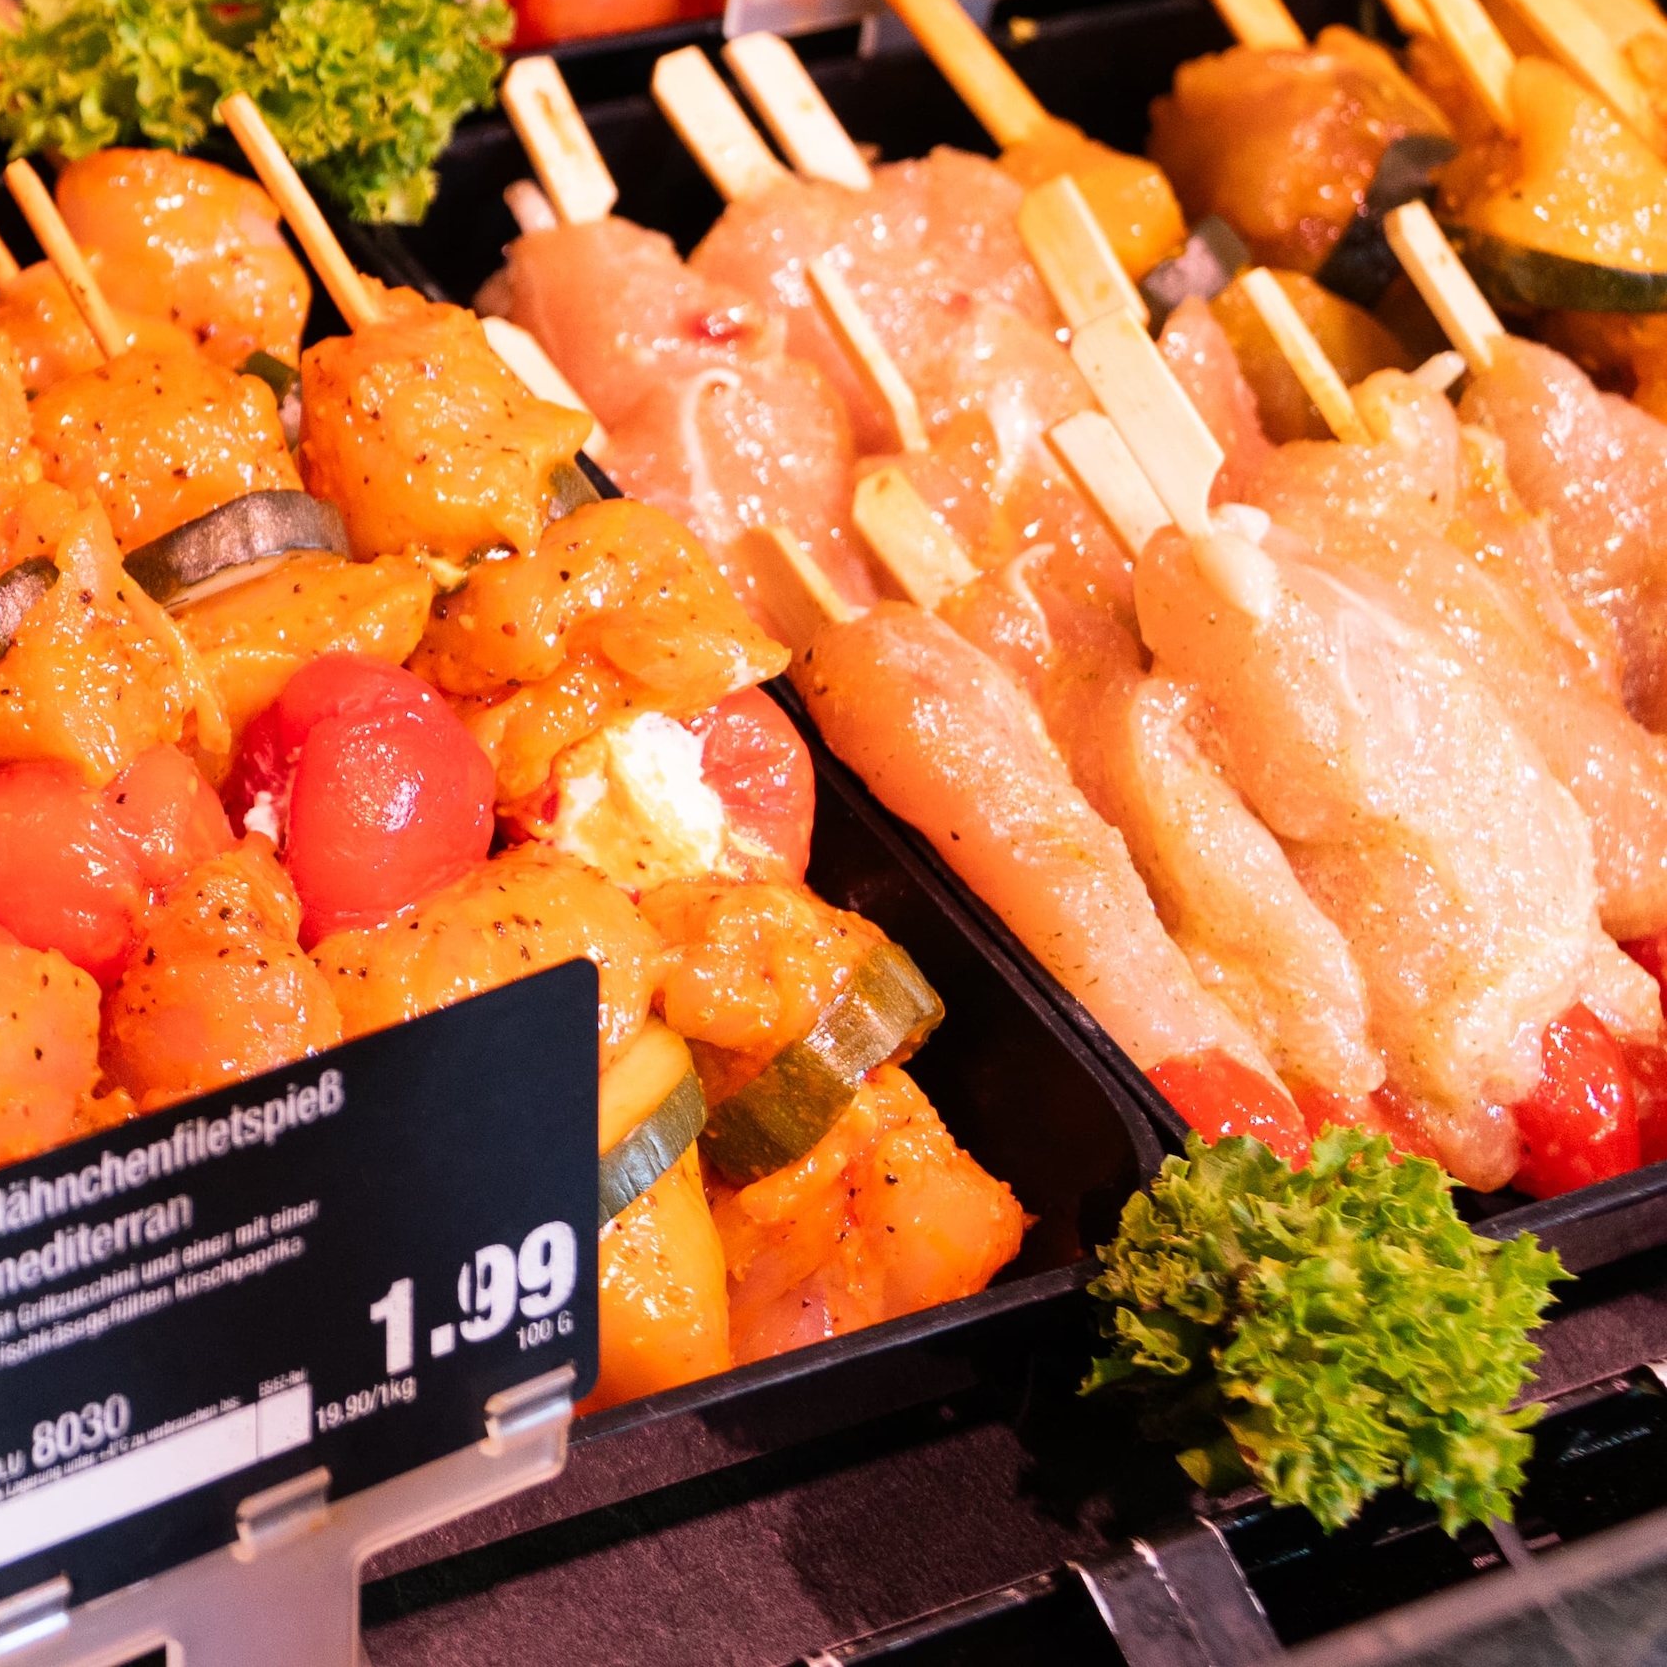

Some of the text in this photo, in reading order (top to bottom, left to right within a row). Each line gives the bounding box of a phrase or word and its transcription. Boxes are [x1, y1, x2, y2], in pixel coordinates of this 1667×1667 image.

[17, 1263, 140, 1330] Grillzucchini
[141, 1247, 182, 1283] und
[181, 1230, 233, 1269] einer
[235, 1214, 269, 1248] mit
[270, 1198, 320, 1235] einer
[174, 1234, 307, 1300] Kirschpaprika
[369, 1220, 578, 1376] 1.99
[517, 1310, 575, 1351] 100 G
[32, 1393, 132, 1469] 8030
[316, 1376, 417, 1433] 19.90/1kg
